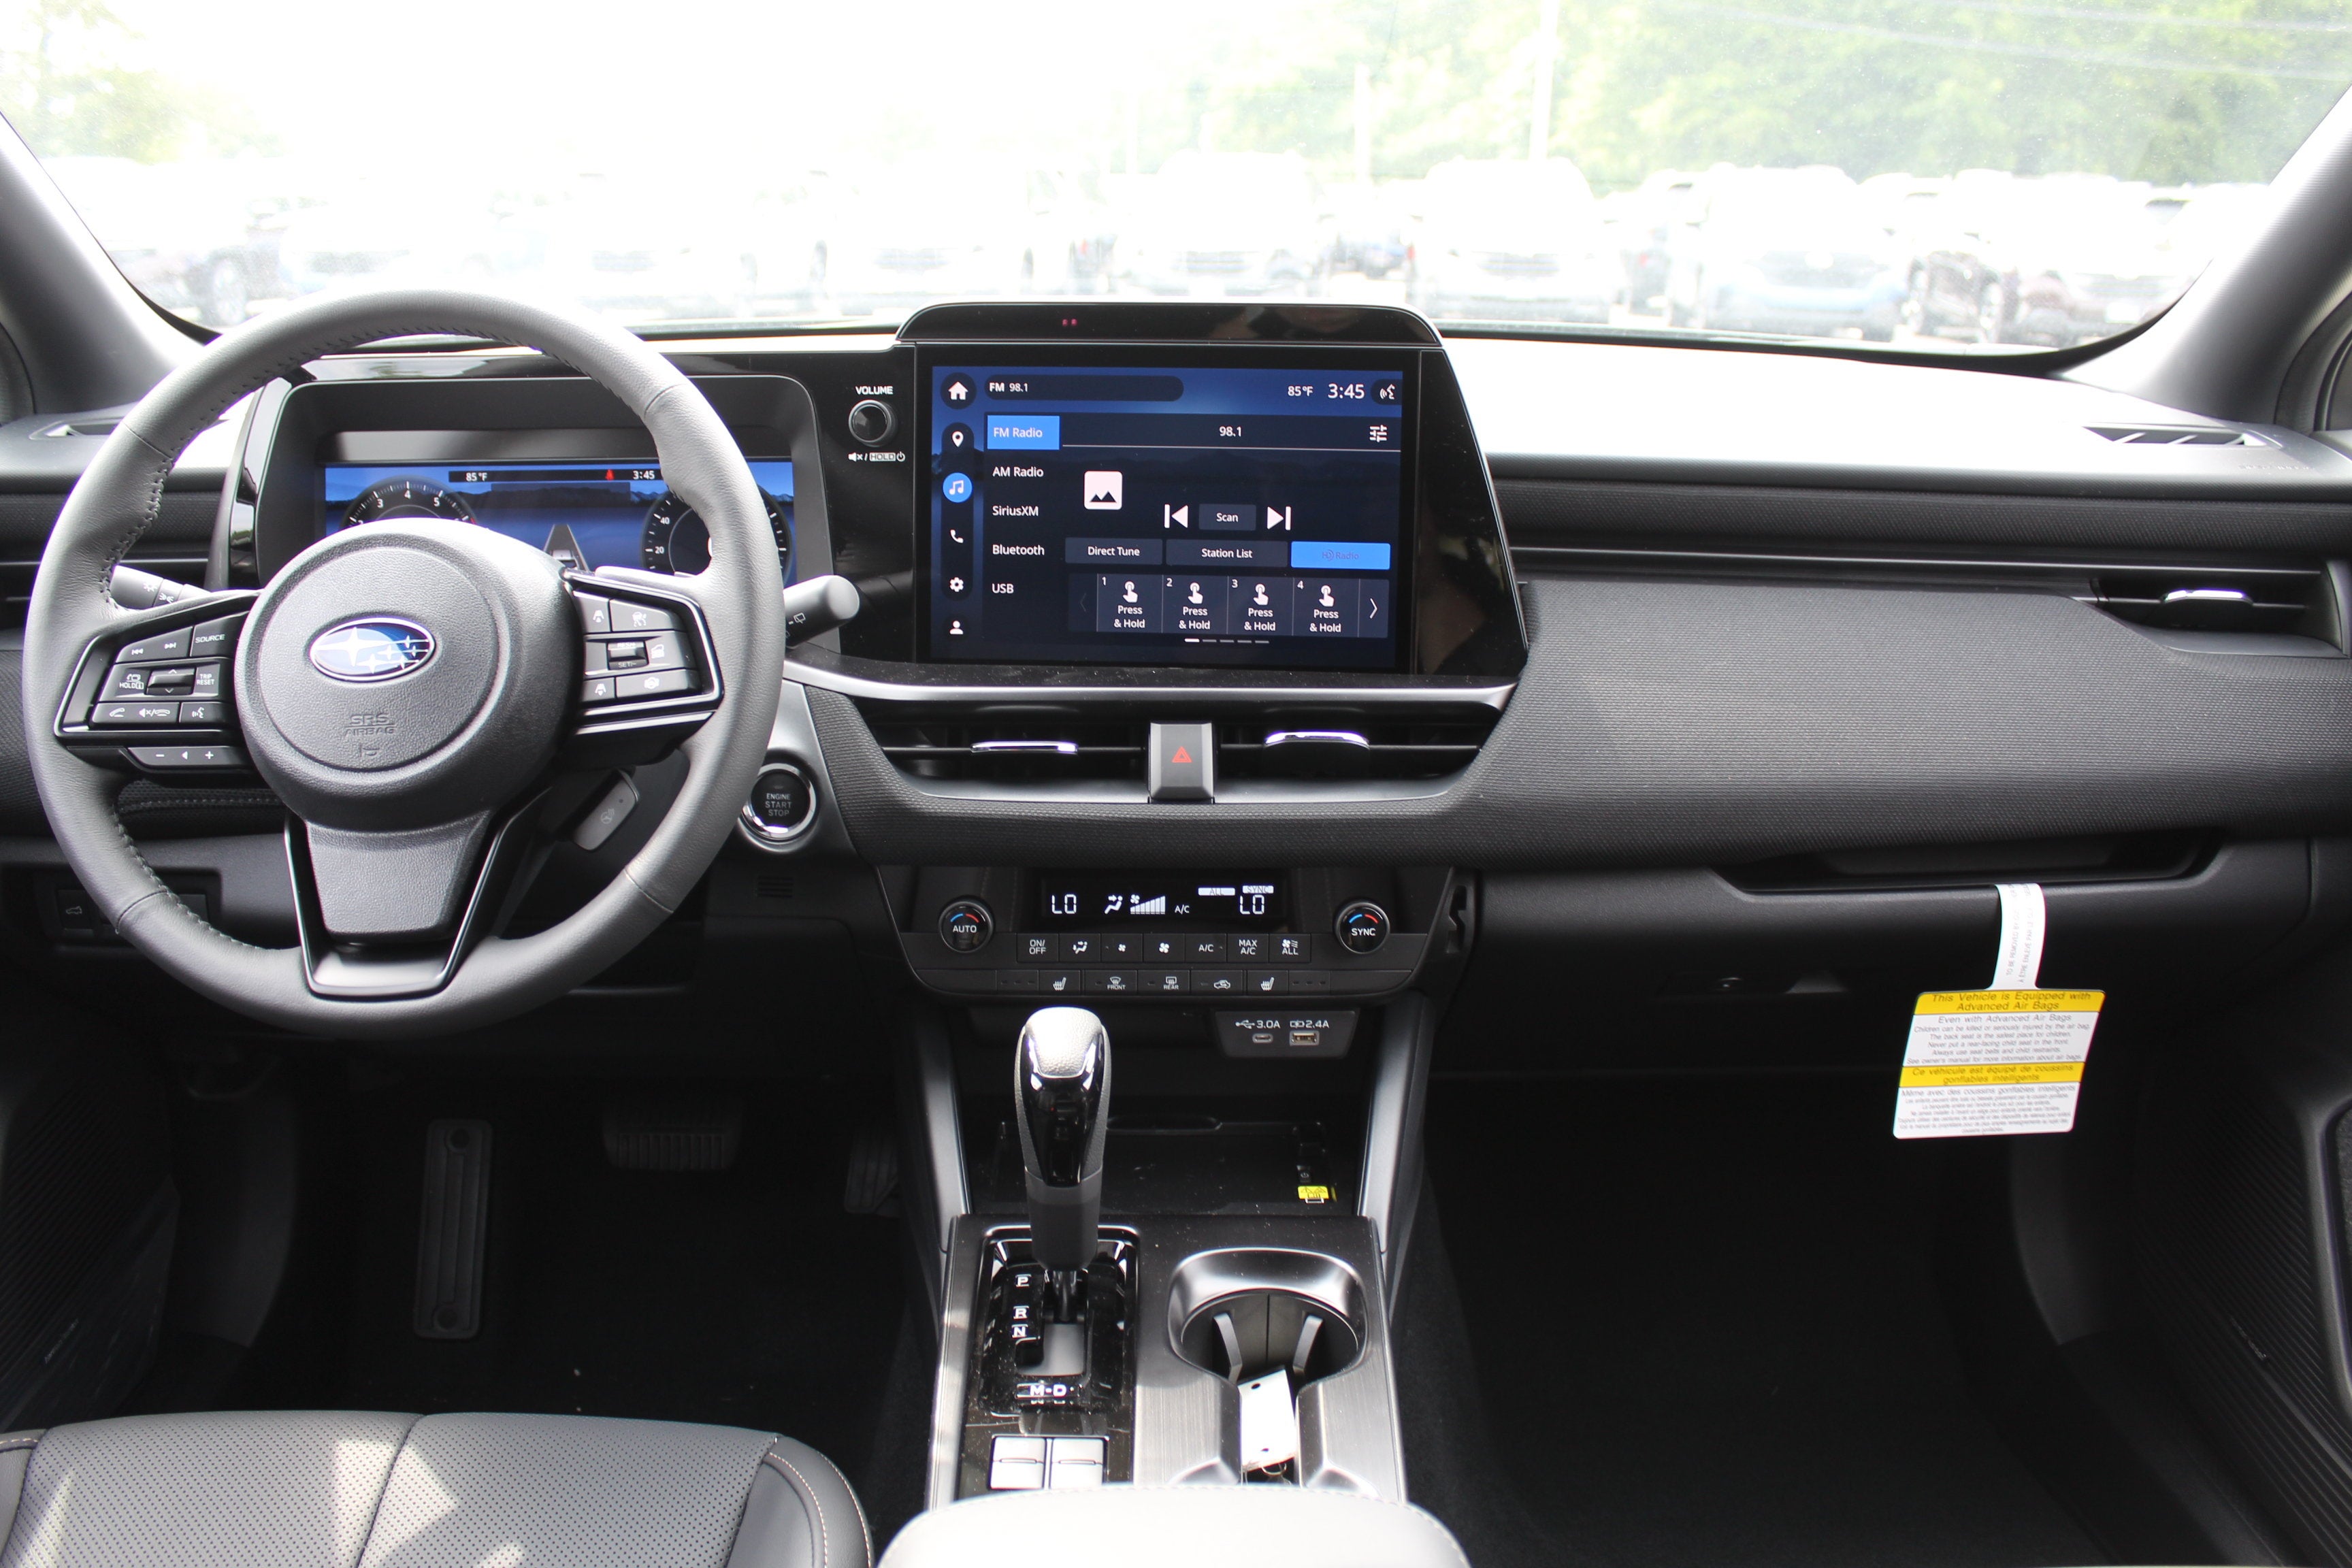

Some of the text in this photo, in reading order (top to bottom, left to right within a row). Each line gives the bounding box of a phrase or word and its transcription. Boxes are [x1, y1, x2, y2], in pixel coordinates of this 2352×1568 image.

[855, 385, 894, 395] VOLUME
[989, 382, 1028, 393] FM 98.1
[1328, 383, 1365, 399] 3:45
[994, 427, 1043, 438] FM Radio
[1219, 426, 1242, 437] 98.1
[633, 470, 655, 480] 3:45
[992, 466, 1044, 477] AM Radio
[404, 490, 411, 499] 4
[377, 498, 384, 508] 3
[434, 497, 440, 507] 5
[992, 506, 1039, 517] SiriusXM
[660, 517, 670, 525] 40
[1216, 512, 1239, 523] Scan
[655, 546, 664, 554] 20
[992, 544, 1045, 555] Bluetooth
[1088, 546, 1140, 557] Direct Tune
[1201, 549, 1253, 559] Station List
[1336, 551, 1359, 559] Radio
[1101, 576, 1107, 585] 1
[1166, 578, 1173, 587] 2
[1232, 579, 1239, 589] 3
[1296, 581, 1305, 589] 4
[992, 583, 1014, 594] USB
[1117, 605, 1143, 615] Press
[1182, 606, 1208, 617] Press
[1247, 608, 1273, 618] Press
[1313, 609, 1339, 619] Press
[1114, 619, 1145, 629] & Hold
[1179, 620, 1211, 630] & Hold
[1244, 621, 1275, 632] & Hold
[1309, 623, 1341, 633] & Hold
[195, 634, 225, 643] SOURCE
[1175, 904, 1190, 915] A/C
[953, 925, 977, 933] AUTO
[1351, 928, 1376, 936] SYNC
[1029, 939, 1045, 947] ON/
[1198, 944, 1214, 952] A/C
[1239, 939, 1258, 947] MAX
[1959, 993, 1996, 1001] Vehicle
[2014, 992, 2064, 1001] Equipped
[2070, 992, 2091, 1000] with
[1957, 1002, 2009, 1011] Advanced
[2033, 1002, 2059, 1011] Bags
[2049, 1014, 2072, 1023] Bags
[1256, 1020, 1281, 1028] 3.0A
[1305, 1020, 1329, 1028] 2.4A
[1912, 1068, 1925, 1076] Ce
[1929, 1066, 1965, 1075] véhicule
[2020, 1064, 2031, 1073] de
[2035, 1064, 2074, 1072] coussins
[1943, 1074, 2040, 1085] gonflables intelligents
[1017, 1276, 1029, 1287] P
[1015, 1307, 1028, 1319] R
[1013, 1325, 1026, 1338] N
